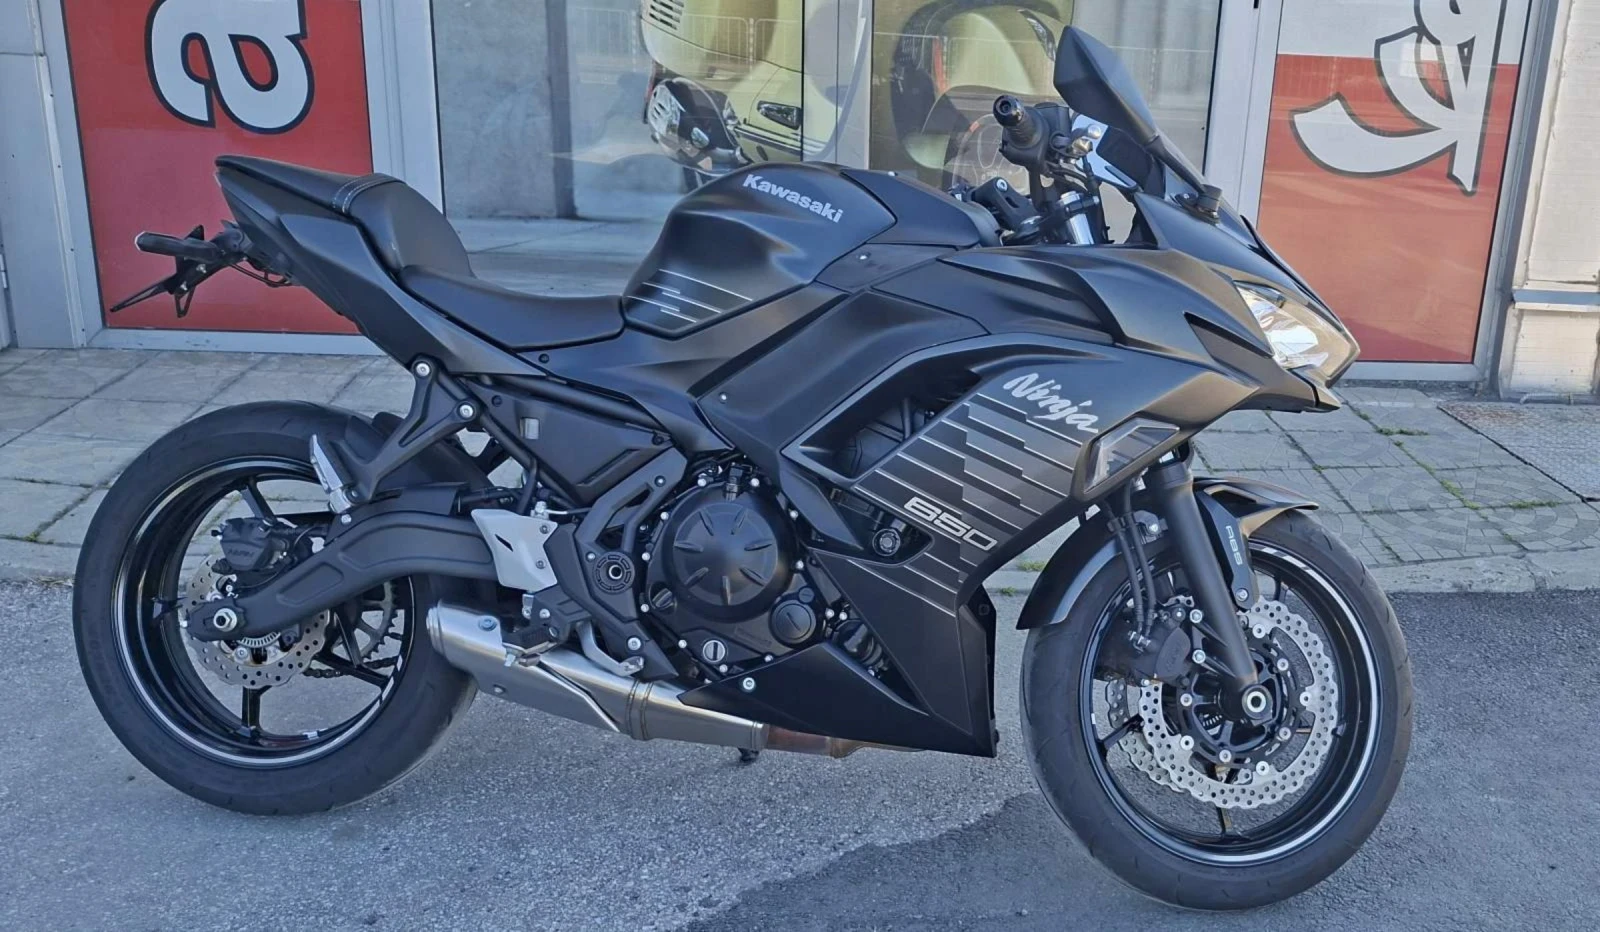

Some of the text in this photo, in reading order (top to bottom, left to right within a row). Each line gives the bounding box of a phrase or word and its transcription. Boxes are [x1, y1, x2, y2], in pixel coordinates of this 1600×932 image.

[742, 174, 844, 223] Kawasaki
[1003, 372, 1099, 433] Ninja
[903, 496, 998, 551] 650
[1225, 525, 1243, 566] ABS
